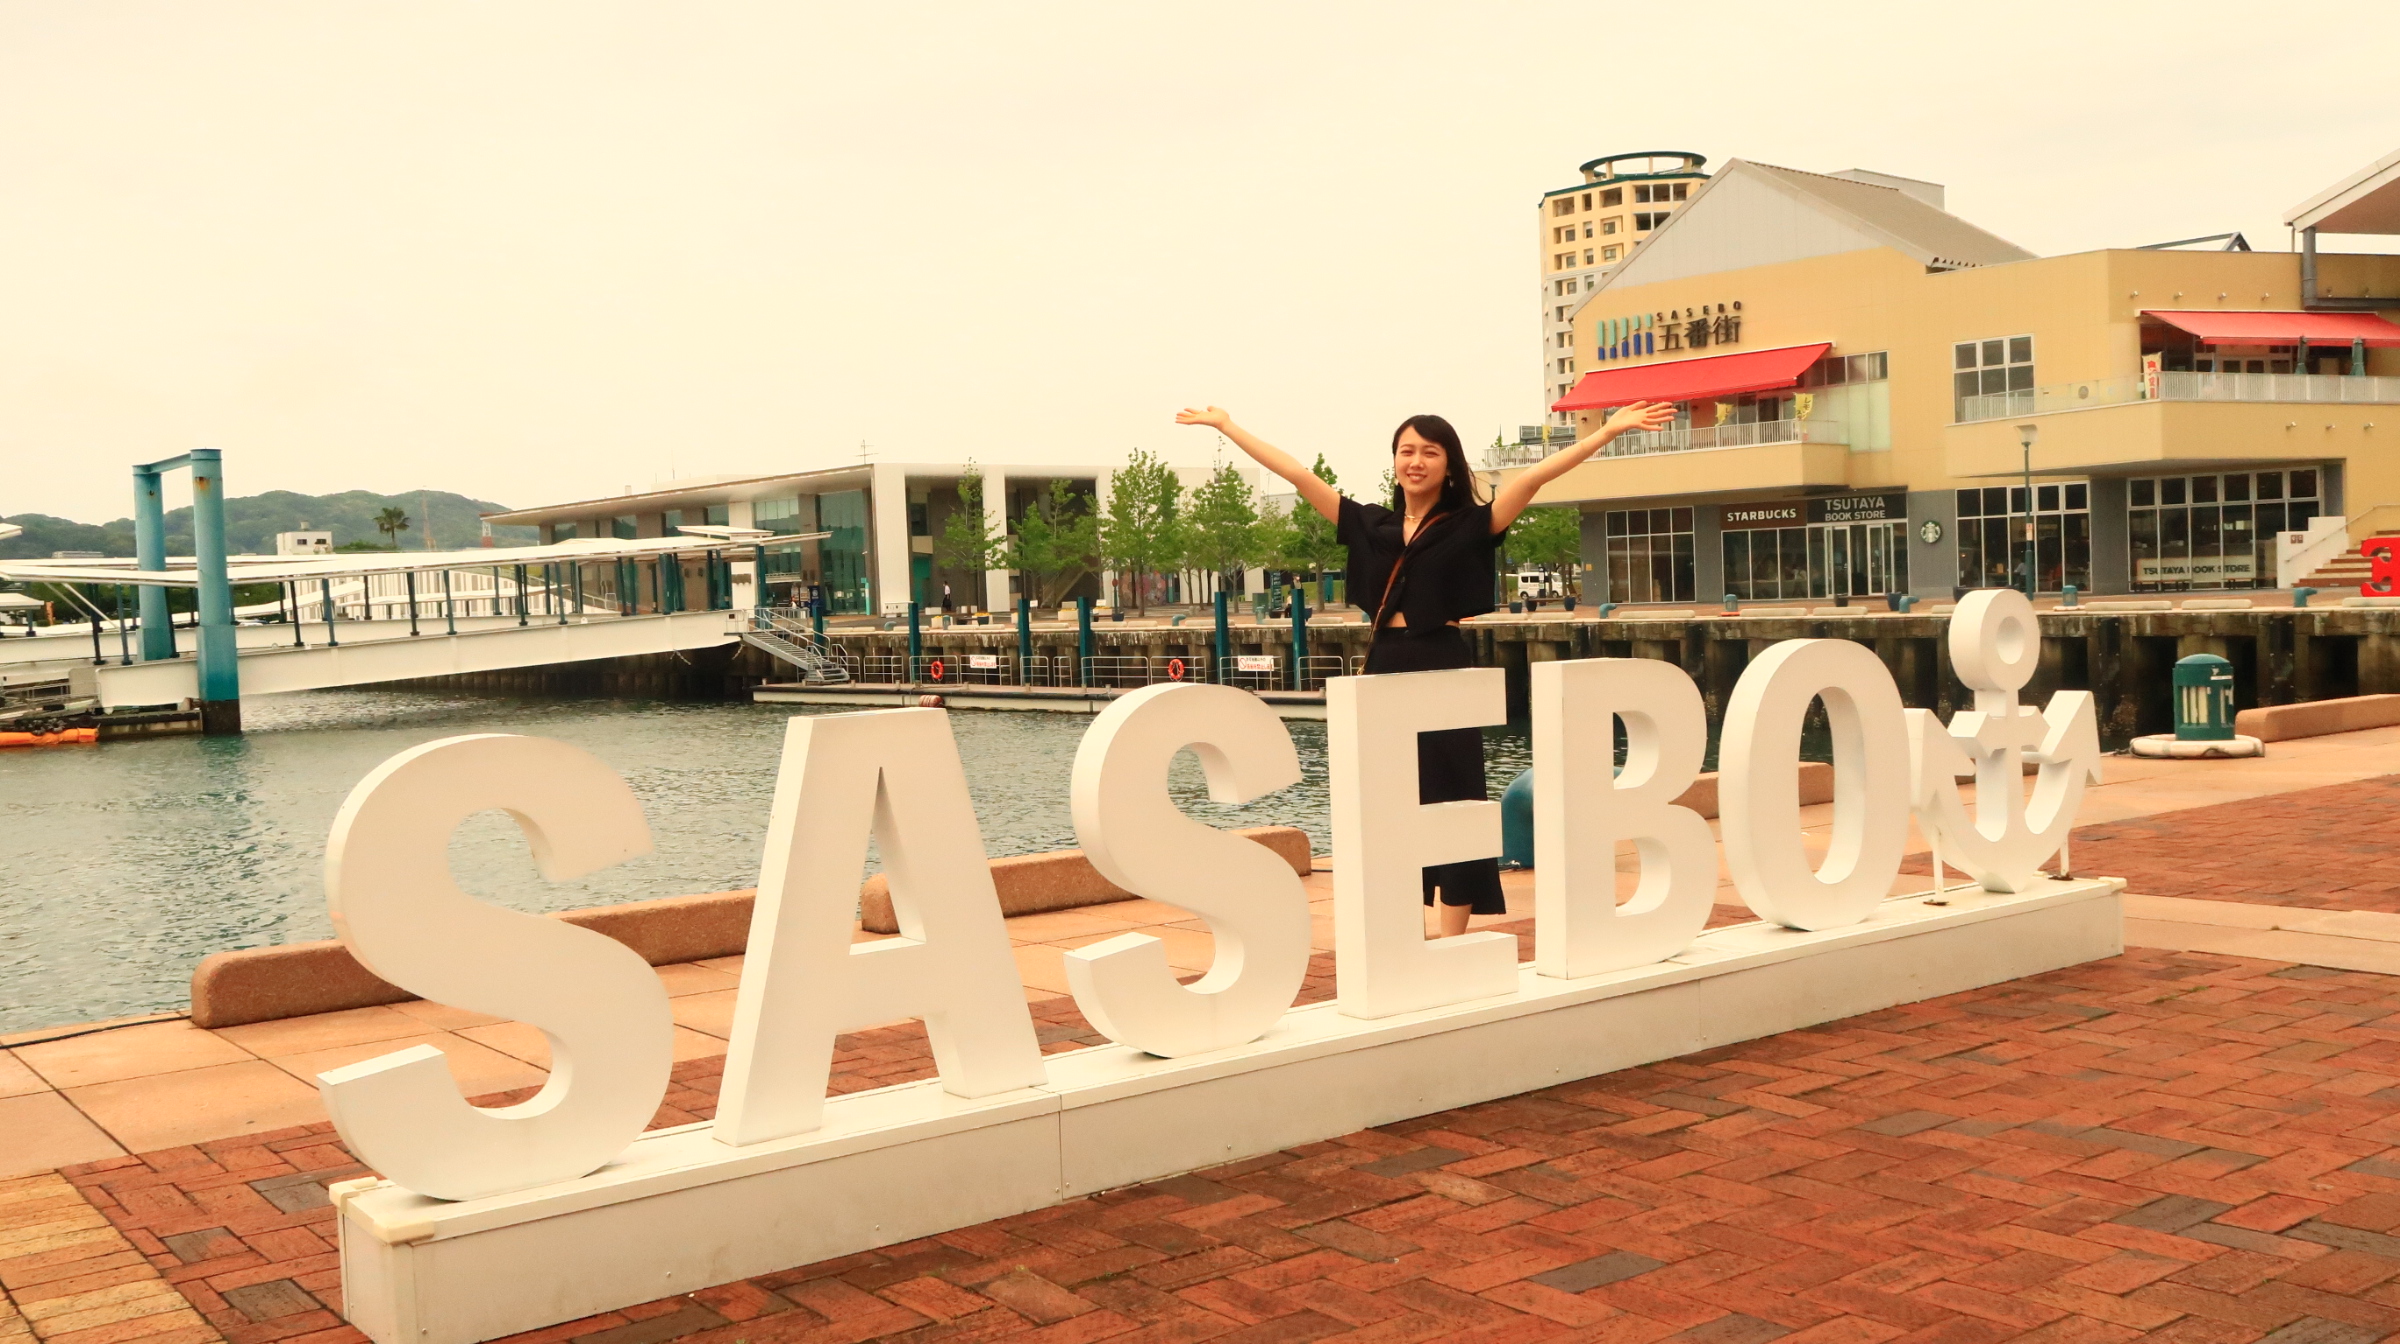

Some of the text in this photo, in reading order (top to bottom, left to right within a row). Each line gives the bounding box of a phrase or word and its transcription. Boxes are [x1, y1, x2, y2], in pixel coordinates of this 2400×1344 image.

[1656, 300, 1741, 322] SASEBO
[1657, 314, 1741, 352] 五番街
[1825, 496, 1886, 511] TSUTAYA
[1727, 508, 1797, 522] STARBUCKS
[1825, 510, 1886, 522] BOOK STORE
[318, 637, 1909, 1201] SASEBO
